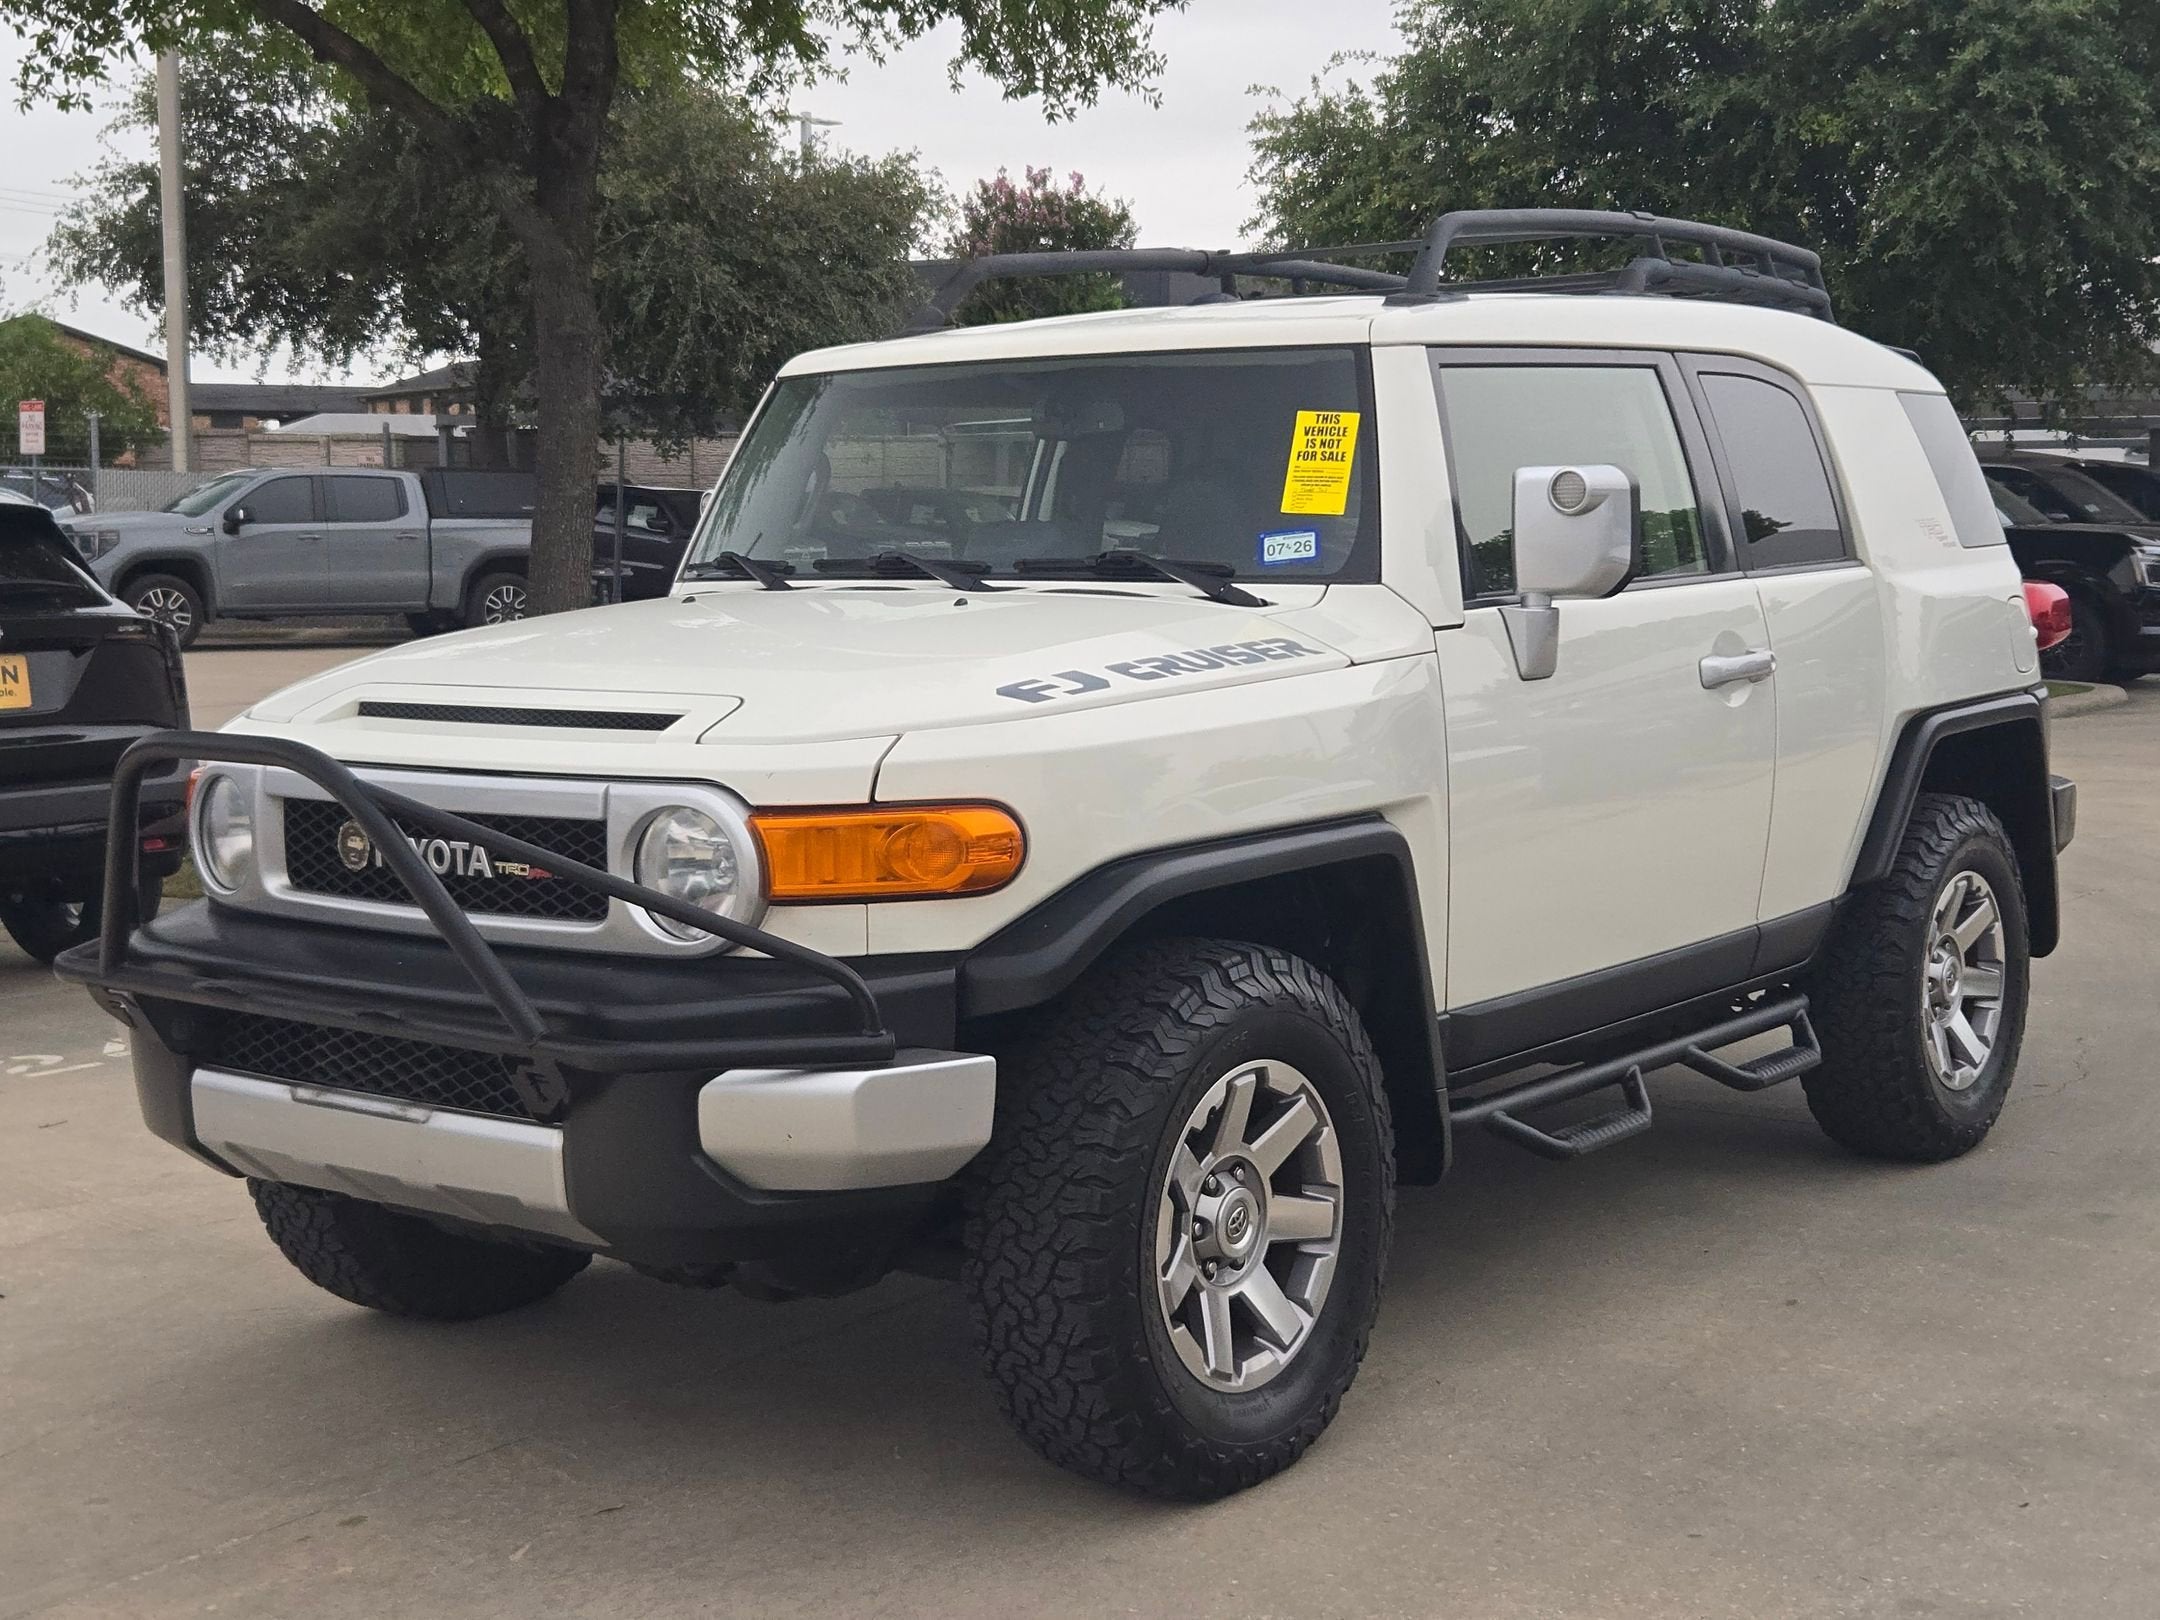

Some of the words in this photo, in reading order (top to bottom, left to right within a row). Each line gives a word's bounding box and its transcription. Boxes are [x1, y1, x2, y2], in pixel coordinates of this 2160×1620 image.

[1316, 413, 1341, 425] THIS
[1304, 426, 1348, 437] VEHICLE
[1305, 438, 1316, 449] IS
[1319, 439, 1342, 449] NOT
[1296, 450, 1317, 461] FOR
[1320, 451, 1346, 462] SALE
[1266, 542, 1286, 557] 07
[1293, 539, 1313, 553] 26
[996, 670, 1112, 703] FJ
[1104, 637, 1326, 681] CRUISER
[375, 837, 493, 879] YOTA
